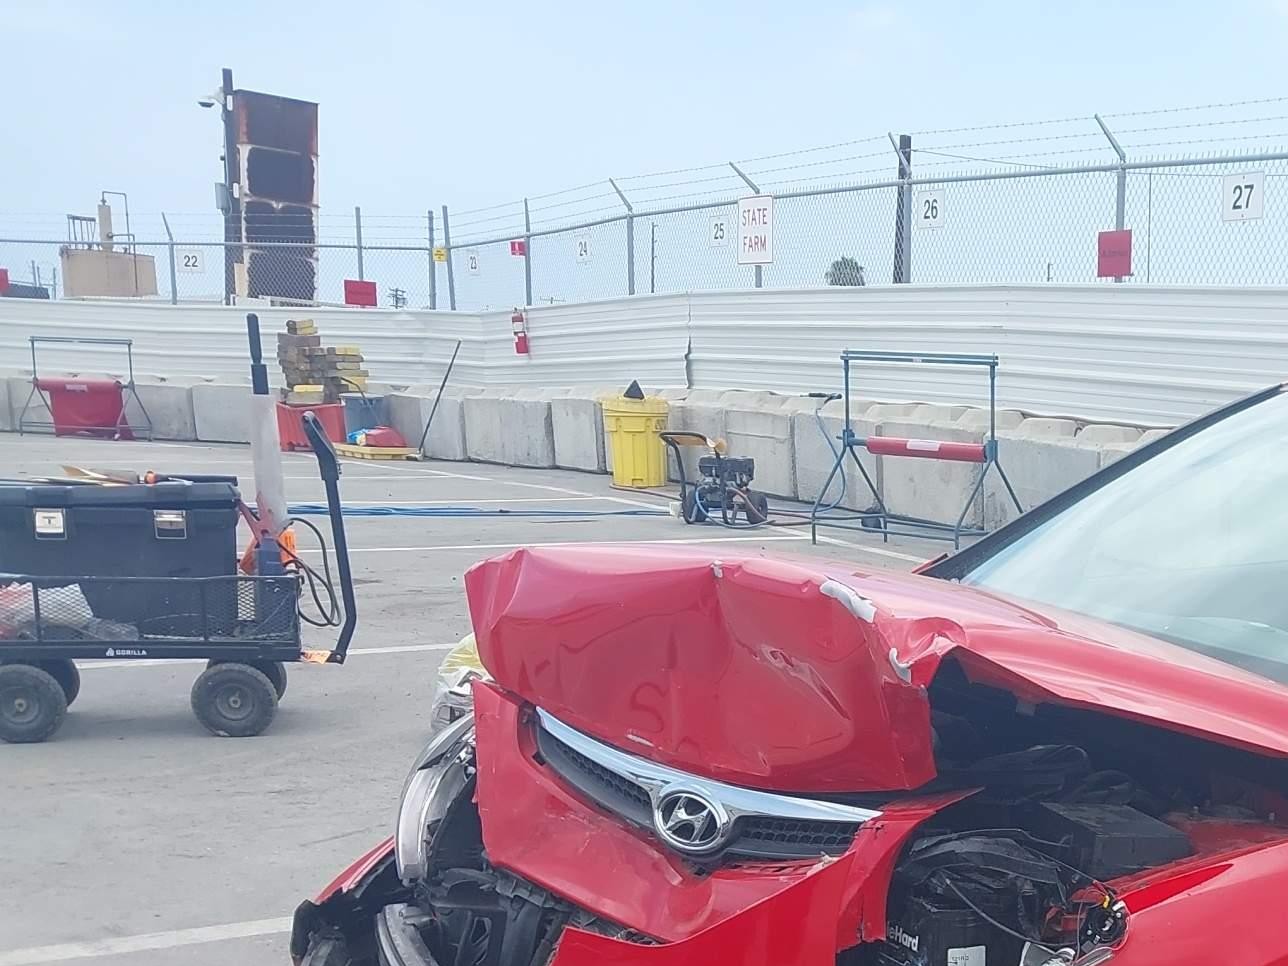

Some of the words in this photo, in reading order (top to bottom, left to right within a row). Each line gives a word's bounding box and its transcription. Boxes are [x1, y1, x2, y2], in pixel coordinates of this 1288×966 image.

[1232, 184, 1255, 210] 27
[742, 207, 768, 227] STATE
[923, 199, 938, 219] 26
[713, 223, 725, 240] 25
[578, 241, 588, 257] 24
[743, 235, 767, 253] FARM
[183, 255, 199, 268] 22
[469, 256, 478, 270] 23
